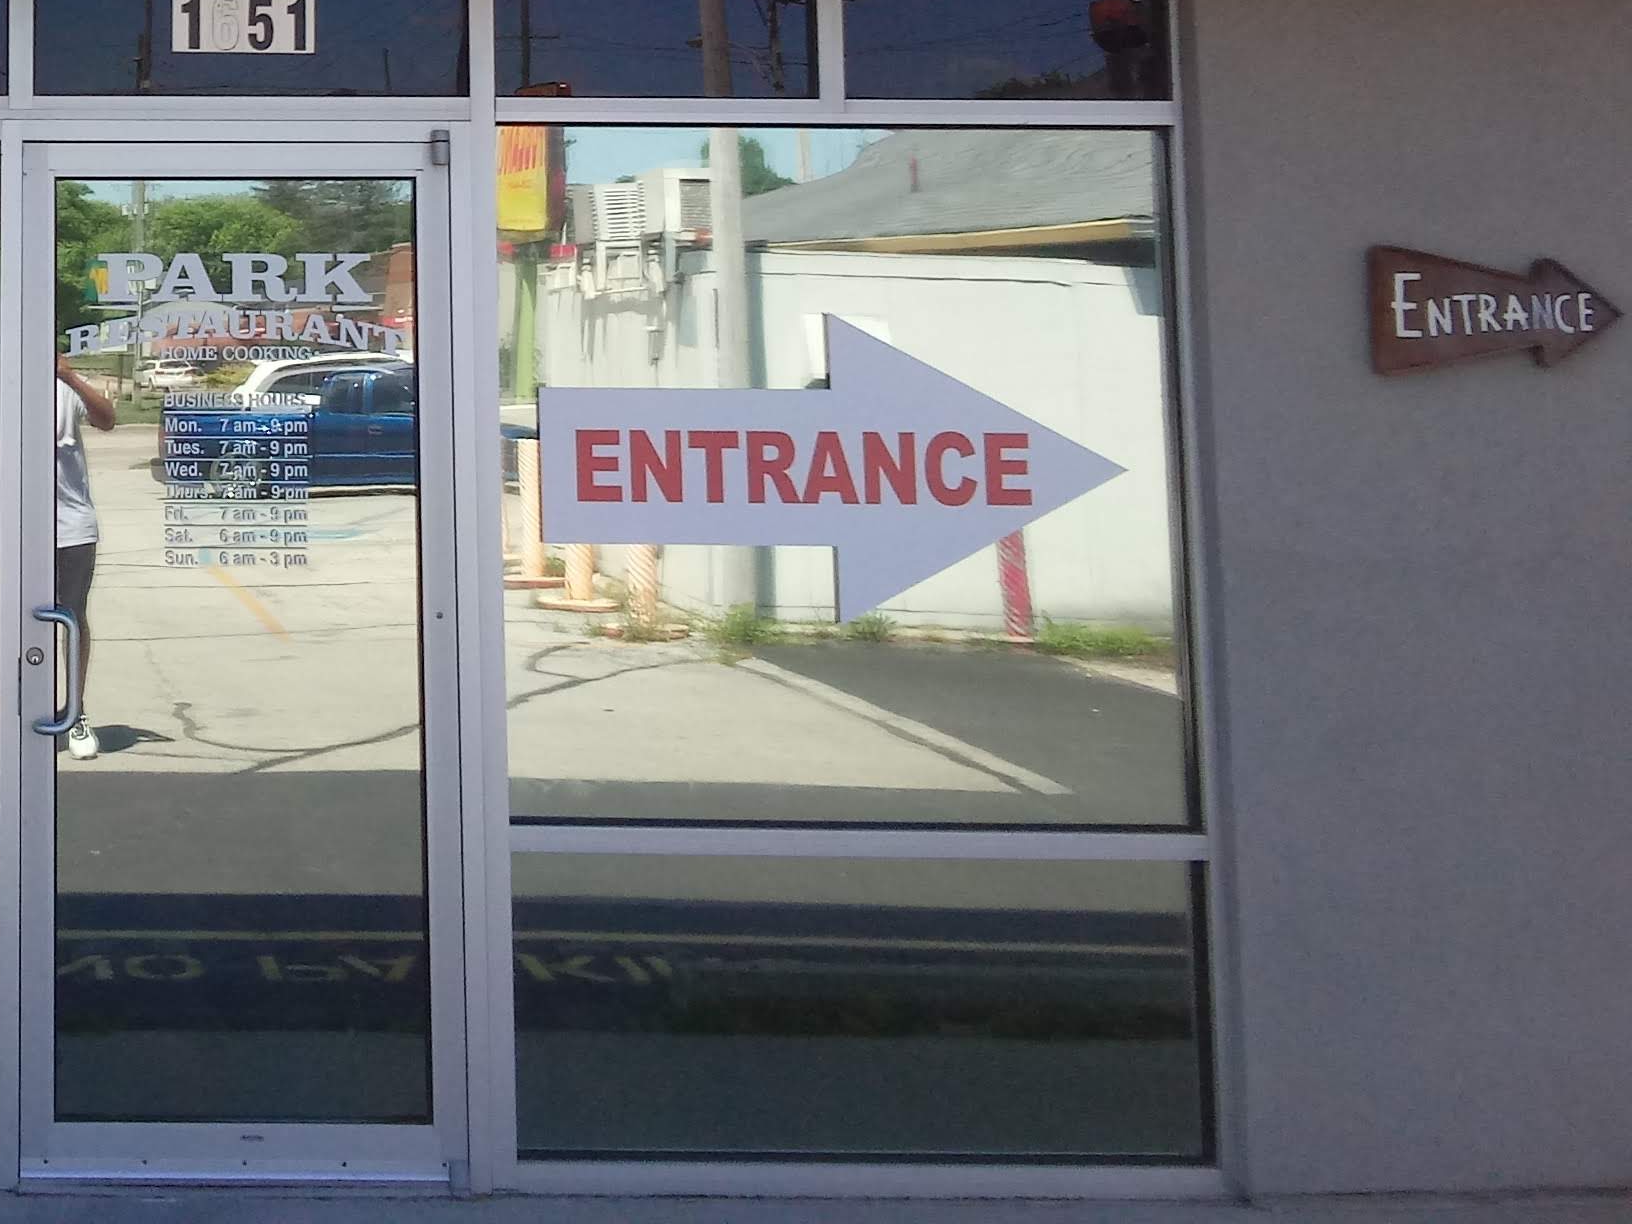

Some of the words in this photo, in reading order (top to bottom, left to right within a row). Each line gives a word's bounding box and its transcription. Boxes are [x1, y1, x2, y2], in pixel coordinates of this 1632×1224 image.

[96, 252, 374, 303] PARK
[1391, 271, 1595, 339] ENTRANCE
[65, 309, 407, 357] RESTAURANT
[164, 392, 244, 408] BUSINESS
[248, 392, 306, 407] HOURS
[165, 418, 203, 433] Mon.
[219, 419, 229, 433] 7
[234, 421, 257, 433] am
[284, 421, 308, 436] pm
[165, 440, 205, 455] Tues.
[219, 441, 229, 455] 7
[233, 443, 256, 455] am
[269, 440, 280, 455] 9
[284, 443, 308, 458] pm
[165, 462, 203, 477] Wed.
[270, 463, 280, 477] 9
[284, 465, 308, 480] pm
[574, 428, 1034, 508] ENTRANCE
[271, 485, 280, 499] 9
[164, 506, 188, 521] Fri.
[219, 506, 228, 520] 7
[233, 508, 256, 520] am
[283, 508, 308, 523] pm
[164, 528, 193, 542] Sat.
[219, 528, 228, 542] 6
[233, 531, 256, 542] am
[284, 531, 308, 545] pm
[164, 550, 199, 565] Sun.
[219, 551, 228, 565] 6
[233, 553, 256, 565] am
[269, 551, 279, 565] 3
[284, 553, 308, 568] pm
